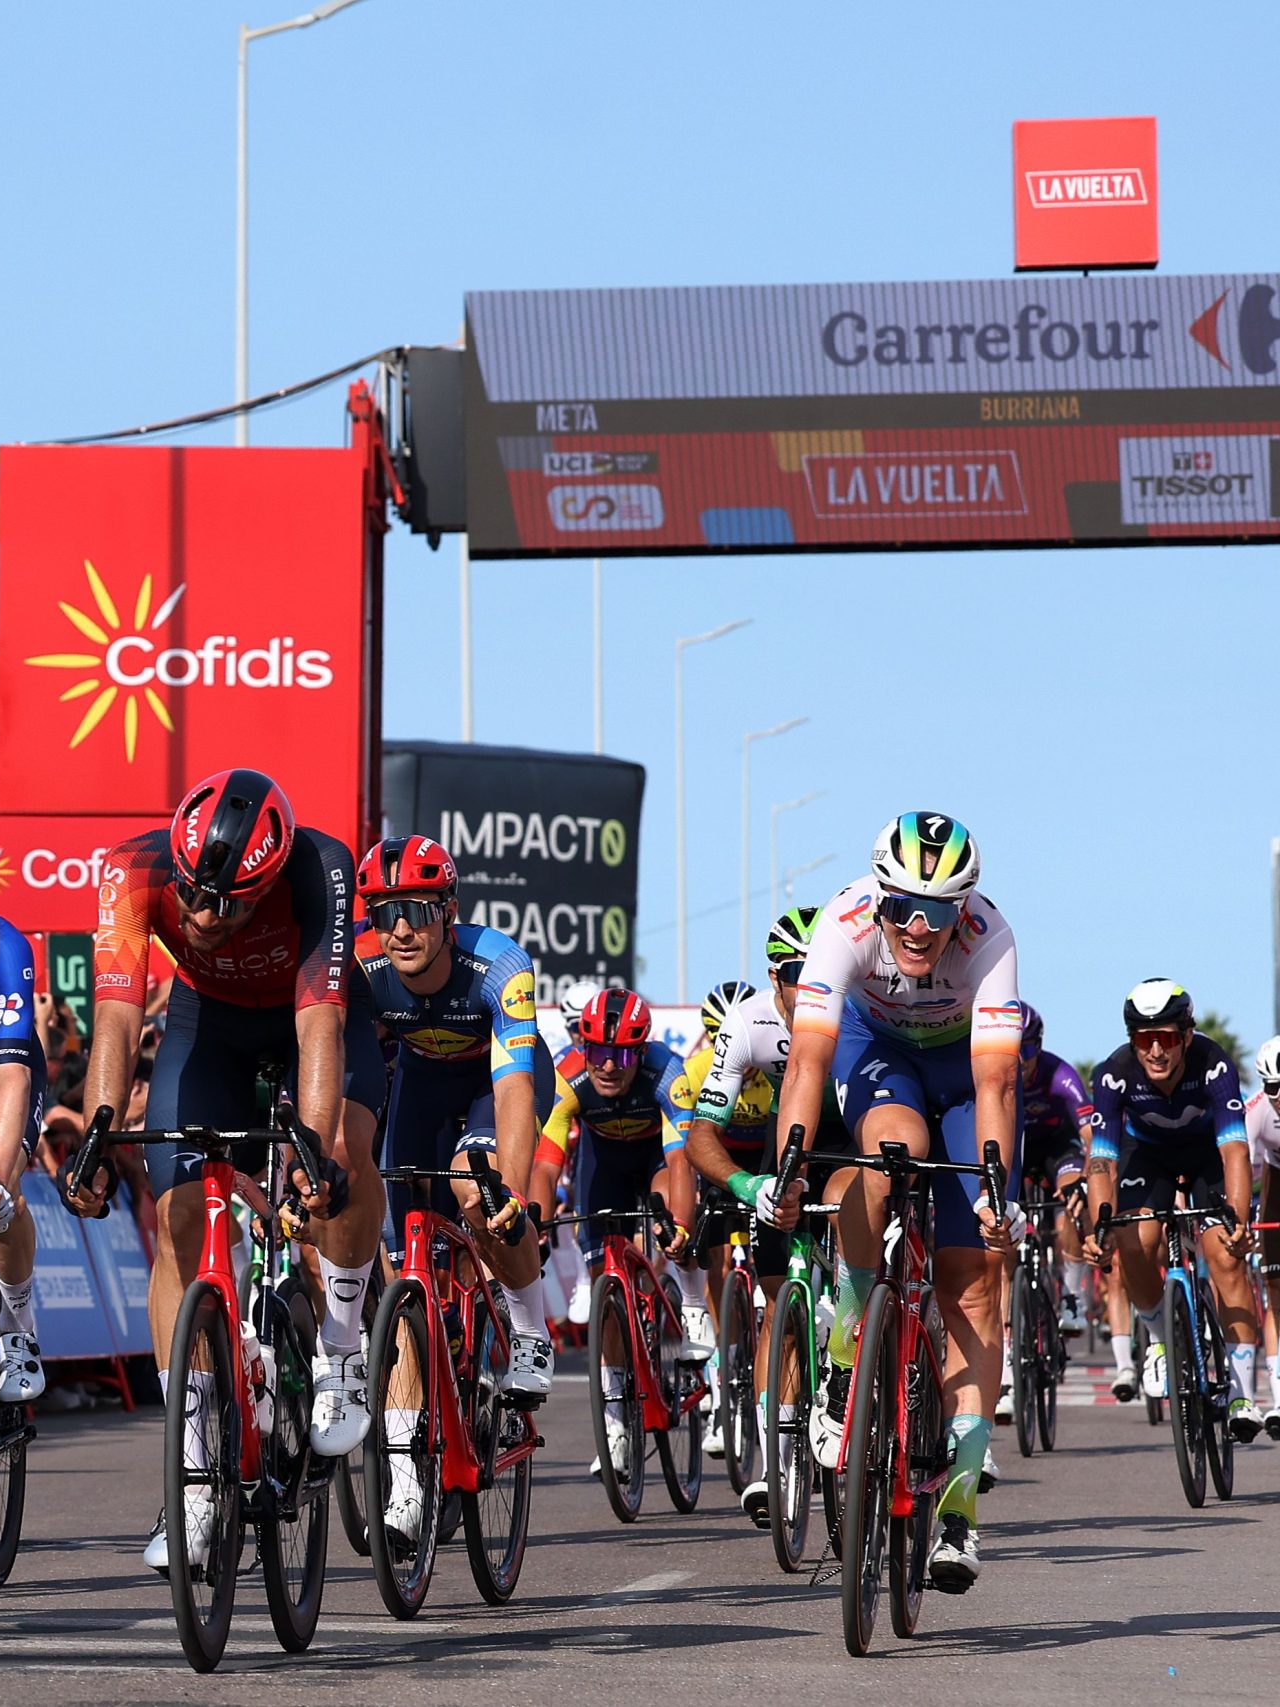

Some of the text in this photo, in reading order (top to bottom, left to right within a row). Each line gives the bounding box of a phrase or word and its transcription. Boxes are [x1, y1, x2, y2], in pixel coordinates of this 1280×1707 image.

[1039, 175, 1135, 200] LA VUELTA
[822, 305, 1159, 367] Carrefour
[536, 403, 598, 432] META
[980, 396, 1081, 421] BURRIANA
[549, 457, 587, 472] UCI
[827, 463, 1005, 504] LA VUELTA
[1131, 473, 1253, 496] TISSOT
[105, 635, 334, 689] Cofidis
[242, 832, 276, 872] KASK
[327, 868, 349, 991] GRENADIER
[710, 1032, 732, 1082] ALEA
